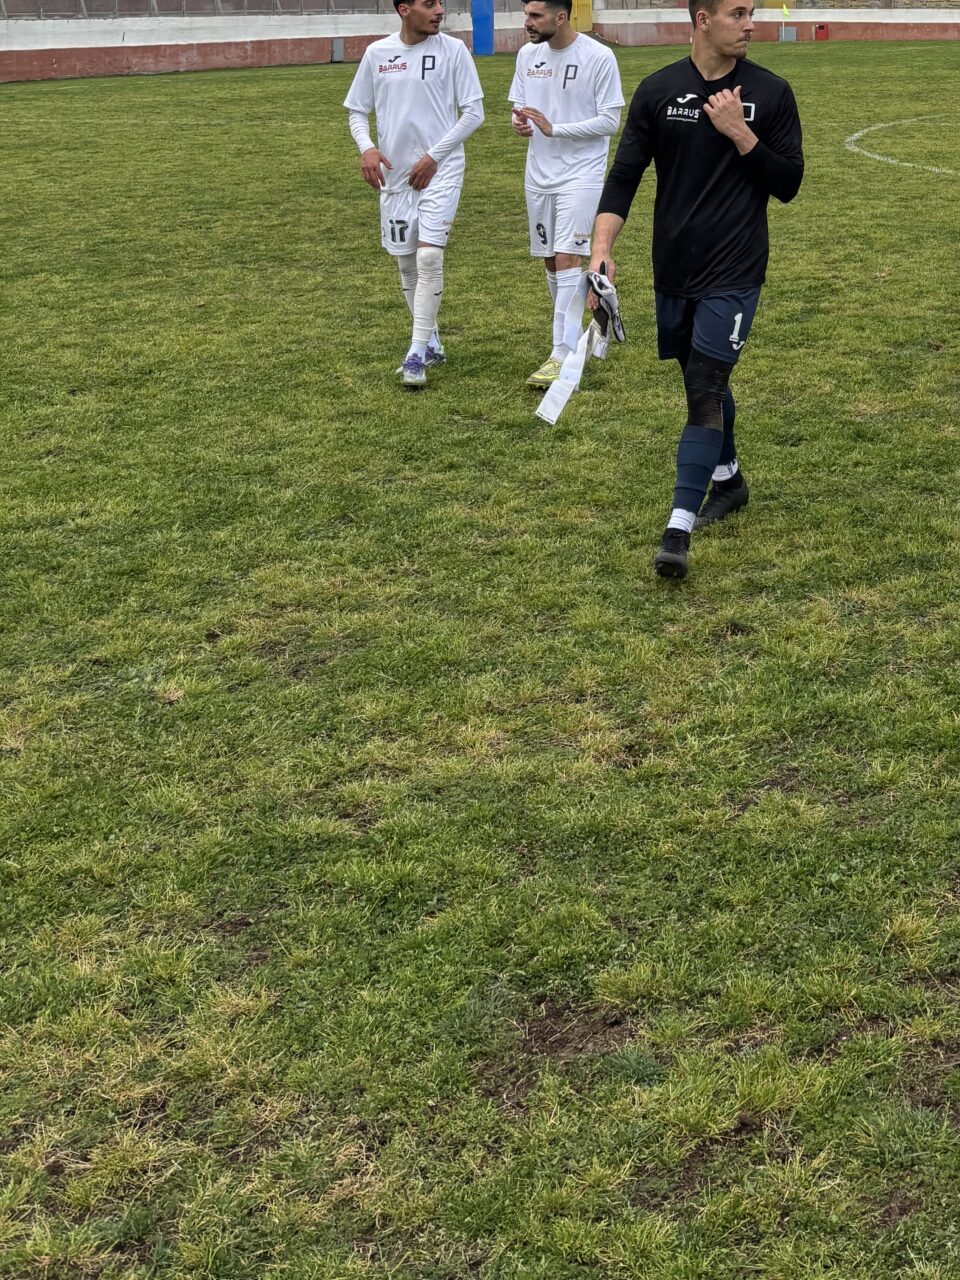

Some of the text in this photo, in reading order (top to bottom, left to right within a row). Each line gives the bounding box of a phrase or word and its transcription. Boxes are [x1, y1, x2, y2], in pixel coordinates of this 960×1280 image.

[379, 55, 436, 80] BARRUS P
[563, 64, 578, 89] P
[667, 106, 700, 119] BARRUS
[389, 219, 409, 243] 17
[535, 222, 548, 246] 9
[729, 312, 743, 342] 1
